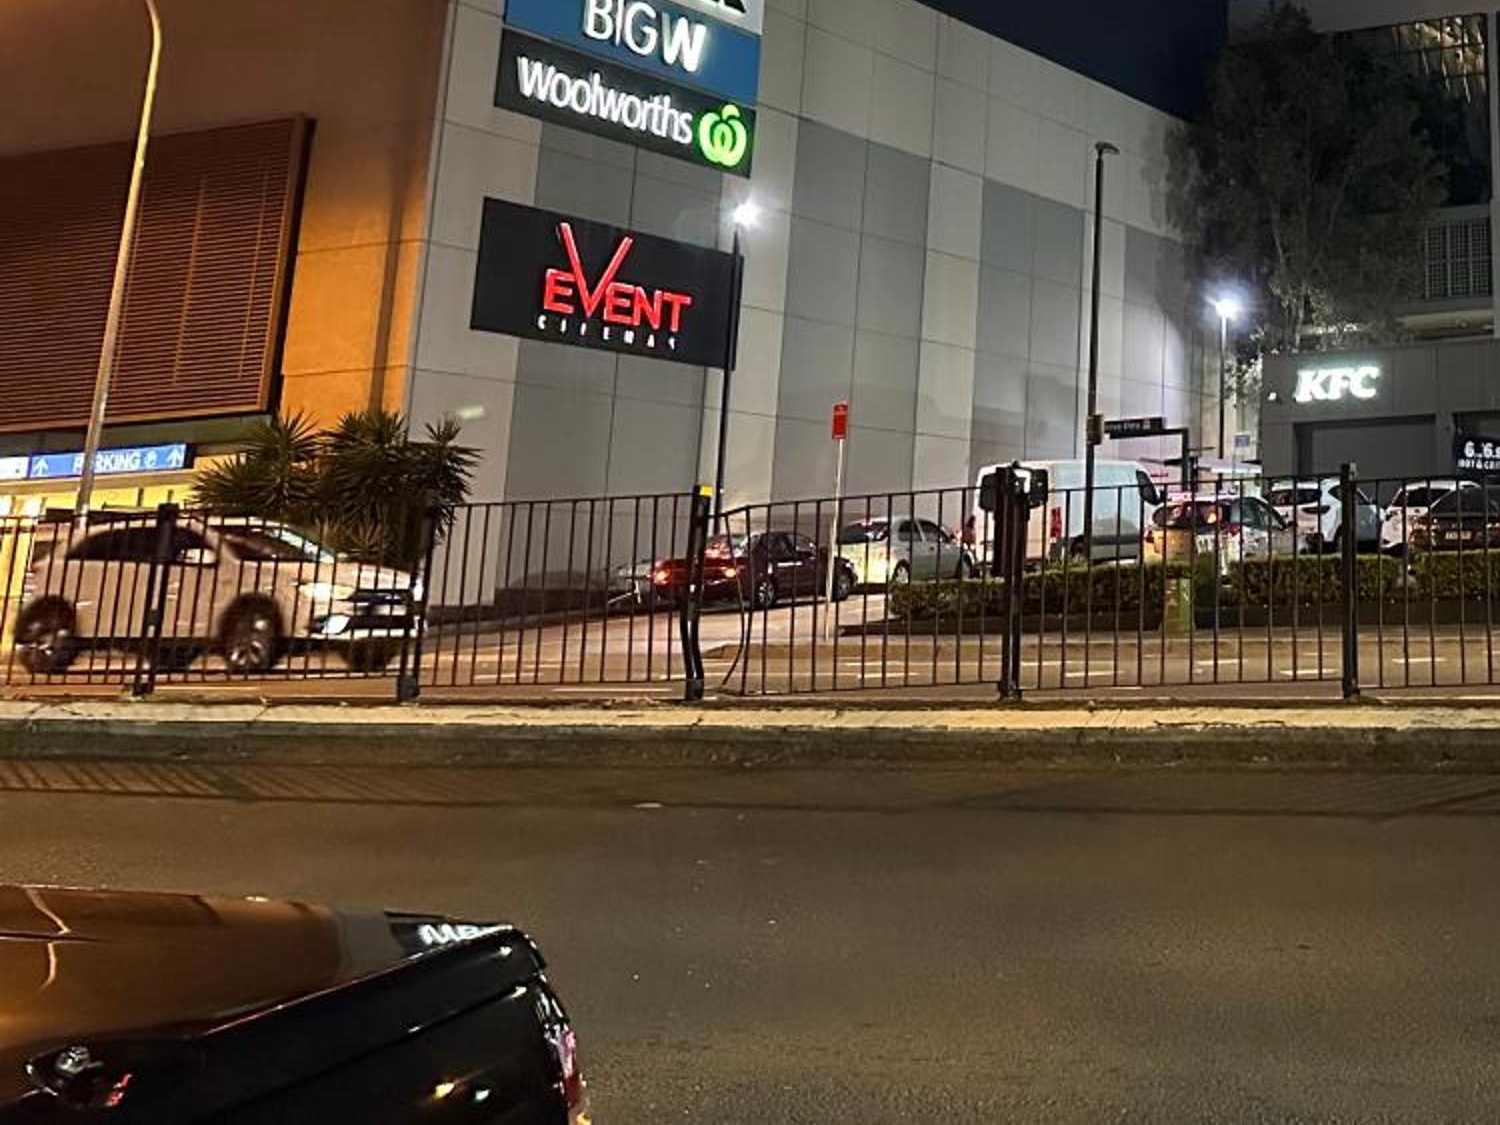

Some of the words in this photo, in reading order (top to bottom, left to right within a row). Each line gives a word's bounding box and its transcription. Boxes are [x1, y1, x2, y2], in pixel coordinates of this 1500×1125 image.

[517, 56, 693, 145] Woolworths
[543, 222, 692, 333] EVENT
[1293, 366, 1380, 403] KFC
[72, 450, 141, 475] PRKING
